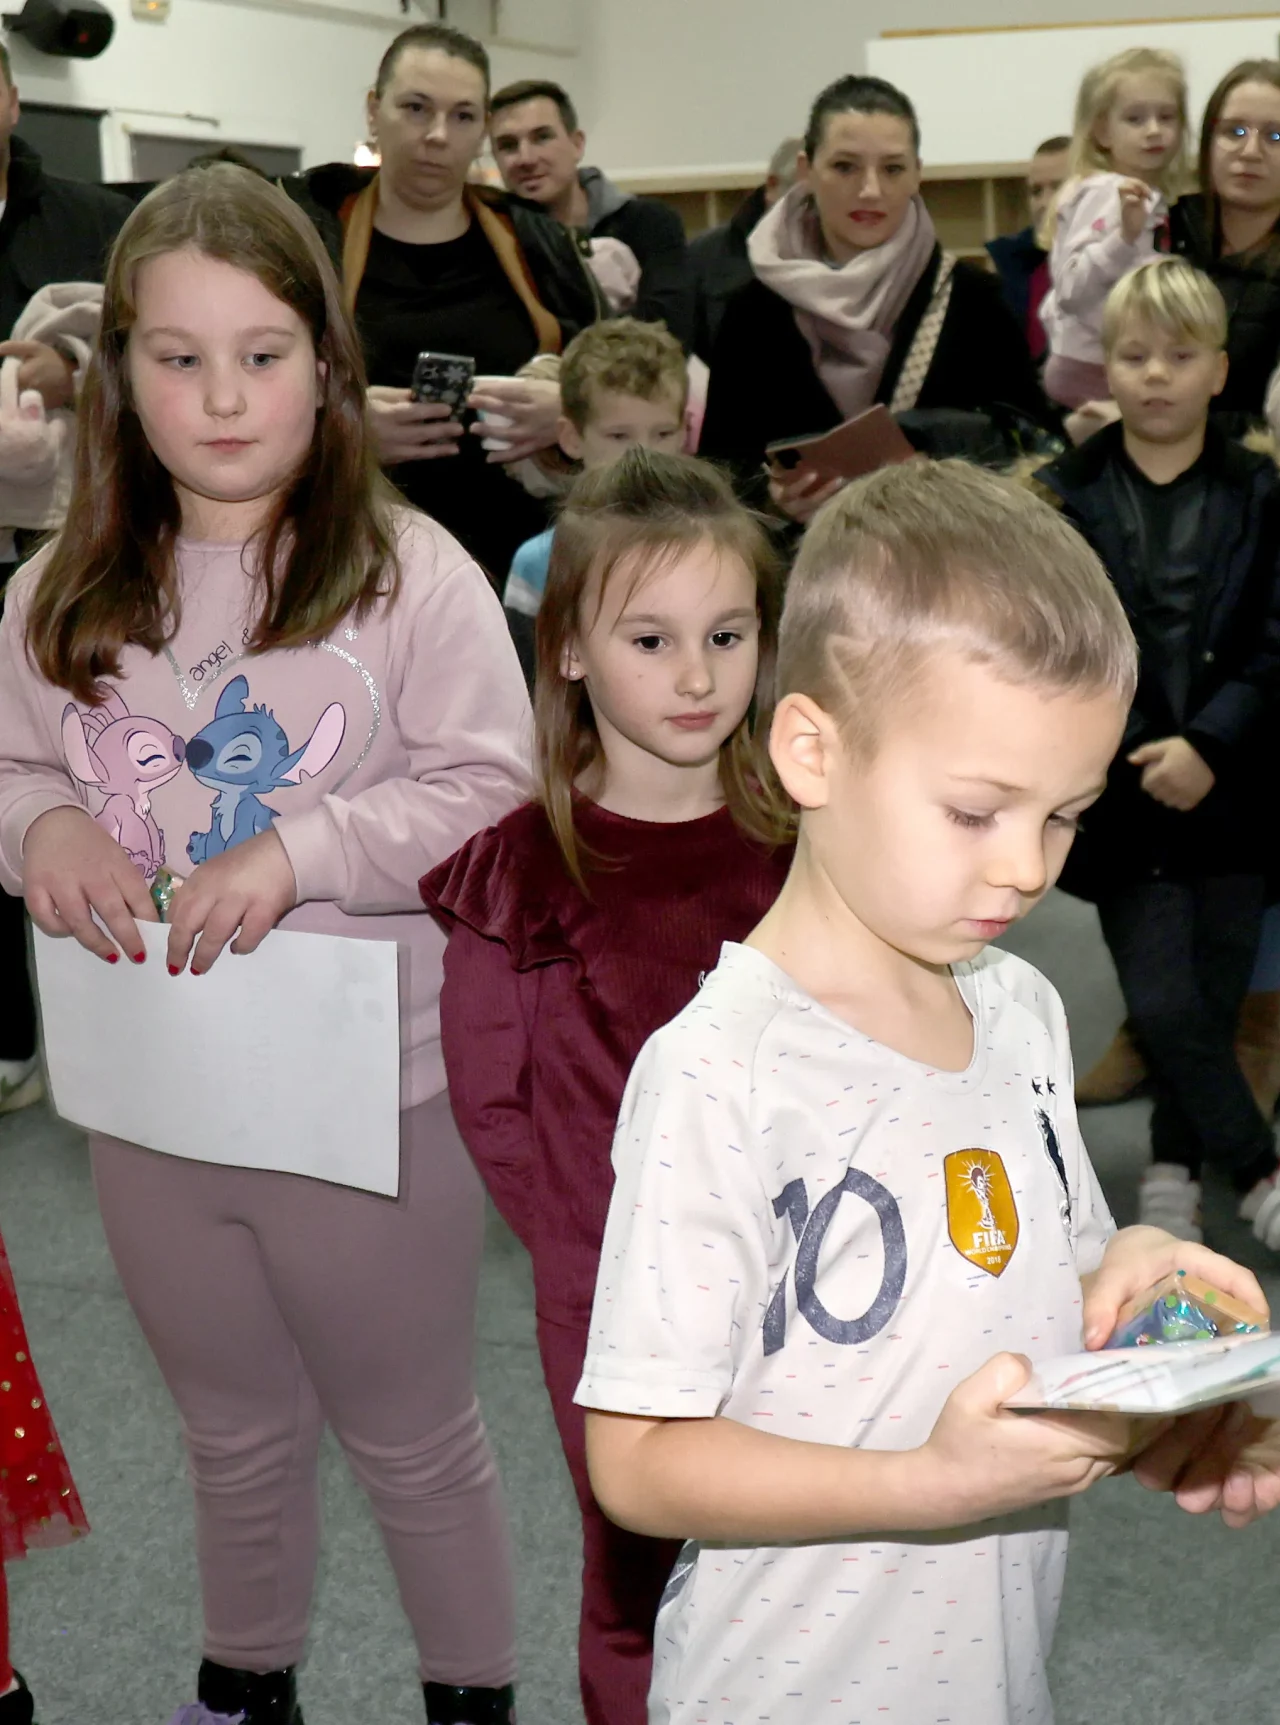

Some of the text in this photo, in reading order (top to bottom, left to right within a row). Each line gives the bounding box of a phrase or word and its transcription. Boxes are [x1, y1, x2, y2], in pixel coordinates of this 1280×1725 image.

[189, 640, 234, 682] angel
[972, 1229, 1006, 1249] FIFA
[762, 1166, 908, 1357] 10
